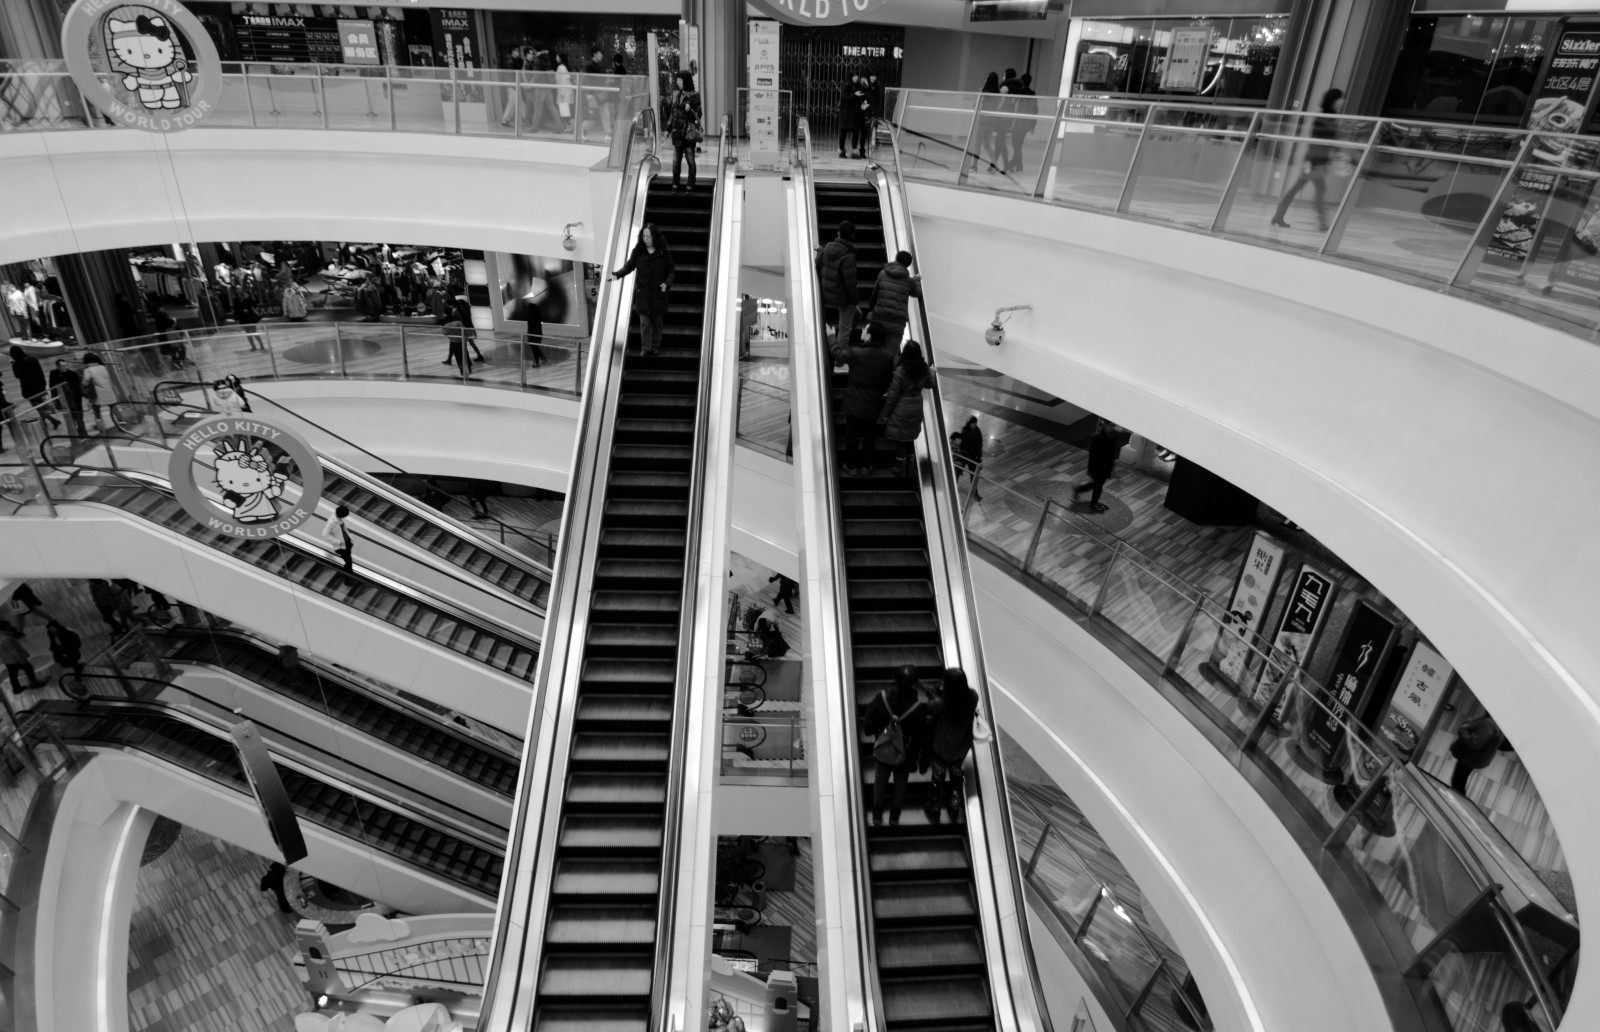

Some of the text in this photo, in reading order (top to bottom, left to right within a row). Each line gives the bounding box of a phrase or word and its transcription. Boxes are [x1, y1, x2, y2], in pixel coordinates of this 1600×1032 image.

[271, 17, 306, 27] IMAX
[441, 19, 469, 27] IMAX
[842, 45, 886, 57] THEATER
[1561, 39, 1600, 51] Sizzler
[109, 100, 211, 130] WORLD TOUR
[183, 420, 281, 450] HELLO KITTY
[207, 507, 308, 537] WORLD TOUR
